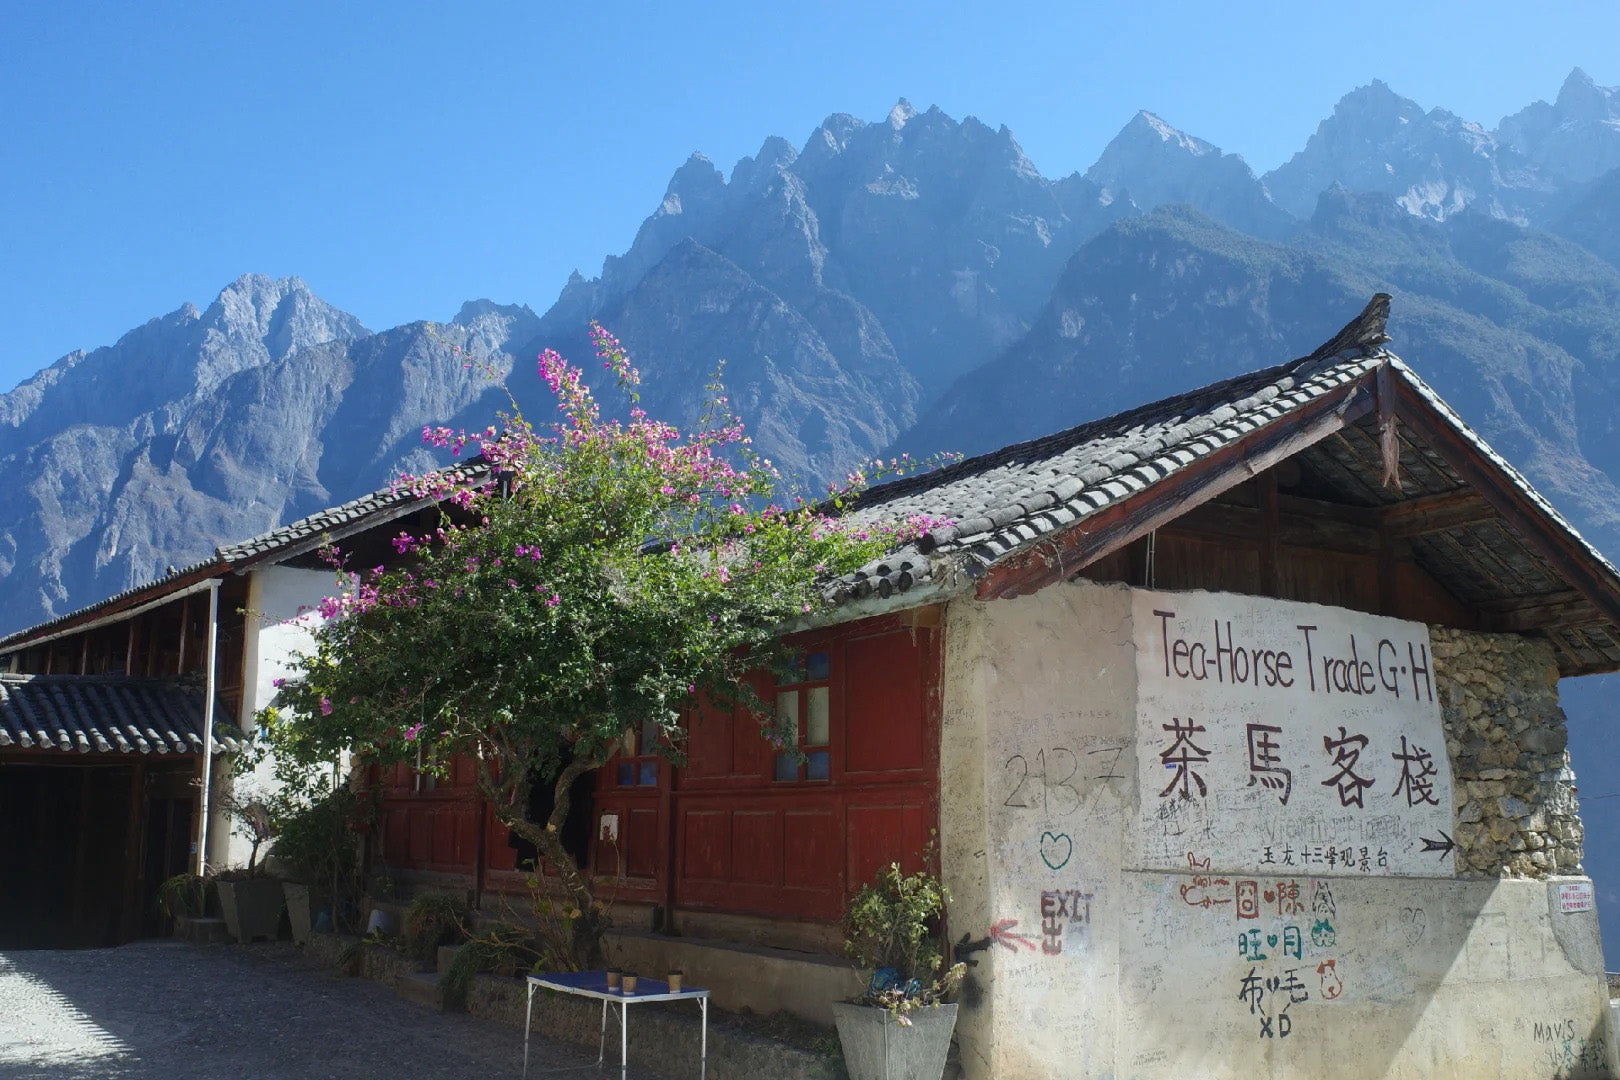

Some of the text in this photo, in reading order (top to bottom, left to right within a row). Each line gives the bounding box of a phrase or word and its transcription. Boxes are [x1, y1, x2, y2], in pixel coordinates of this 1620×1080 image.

[1153, 609, 1294, 688] Tea-Horse
[1297, 625, 1376, 696] Trade
[1259, 843, 1389, 873] 玉龙十三峰观景台
[1040, 888, 1095, 924] EXIT
[1041, 917, 1063, 956] 出
